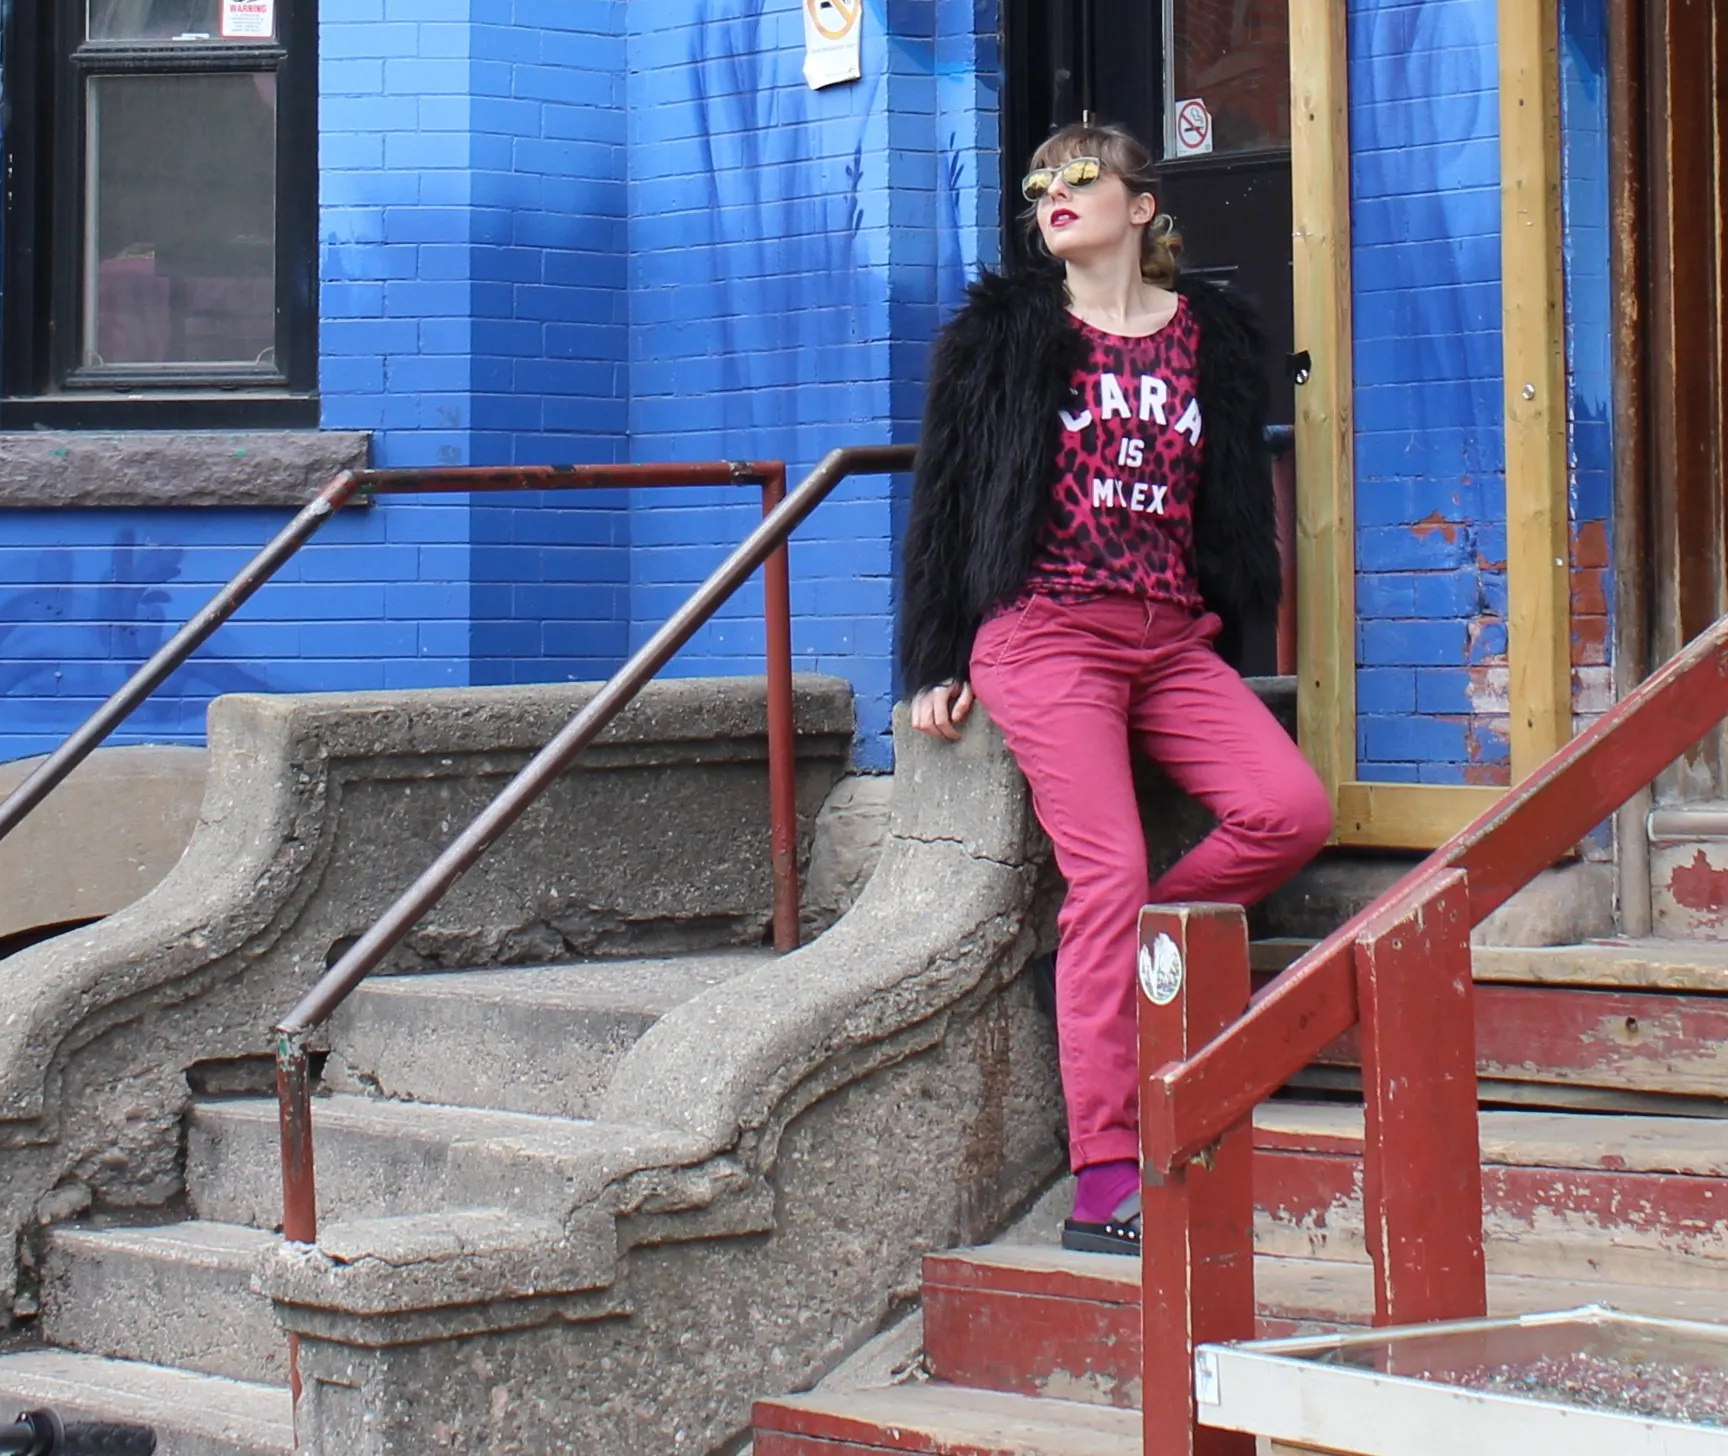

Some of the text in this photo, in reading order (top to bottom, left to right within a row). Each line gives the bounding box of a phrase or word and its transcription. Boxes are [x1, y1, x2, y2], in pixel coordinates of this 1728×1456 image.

[230, 4, 268, 14] WARNING
[1118, 437, 1144, 468] IS
[1130, 482, 1168, 515] EX
